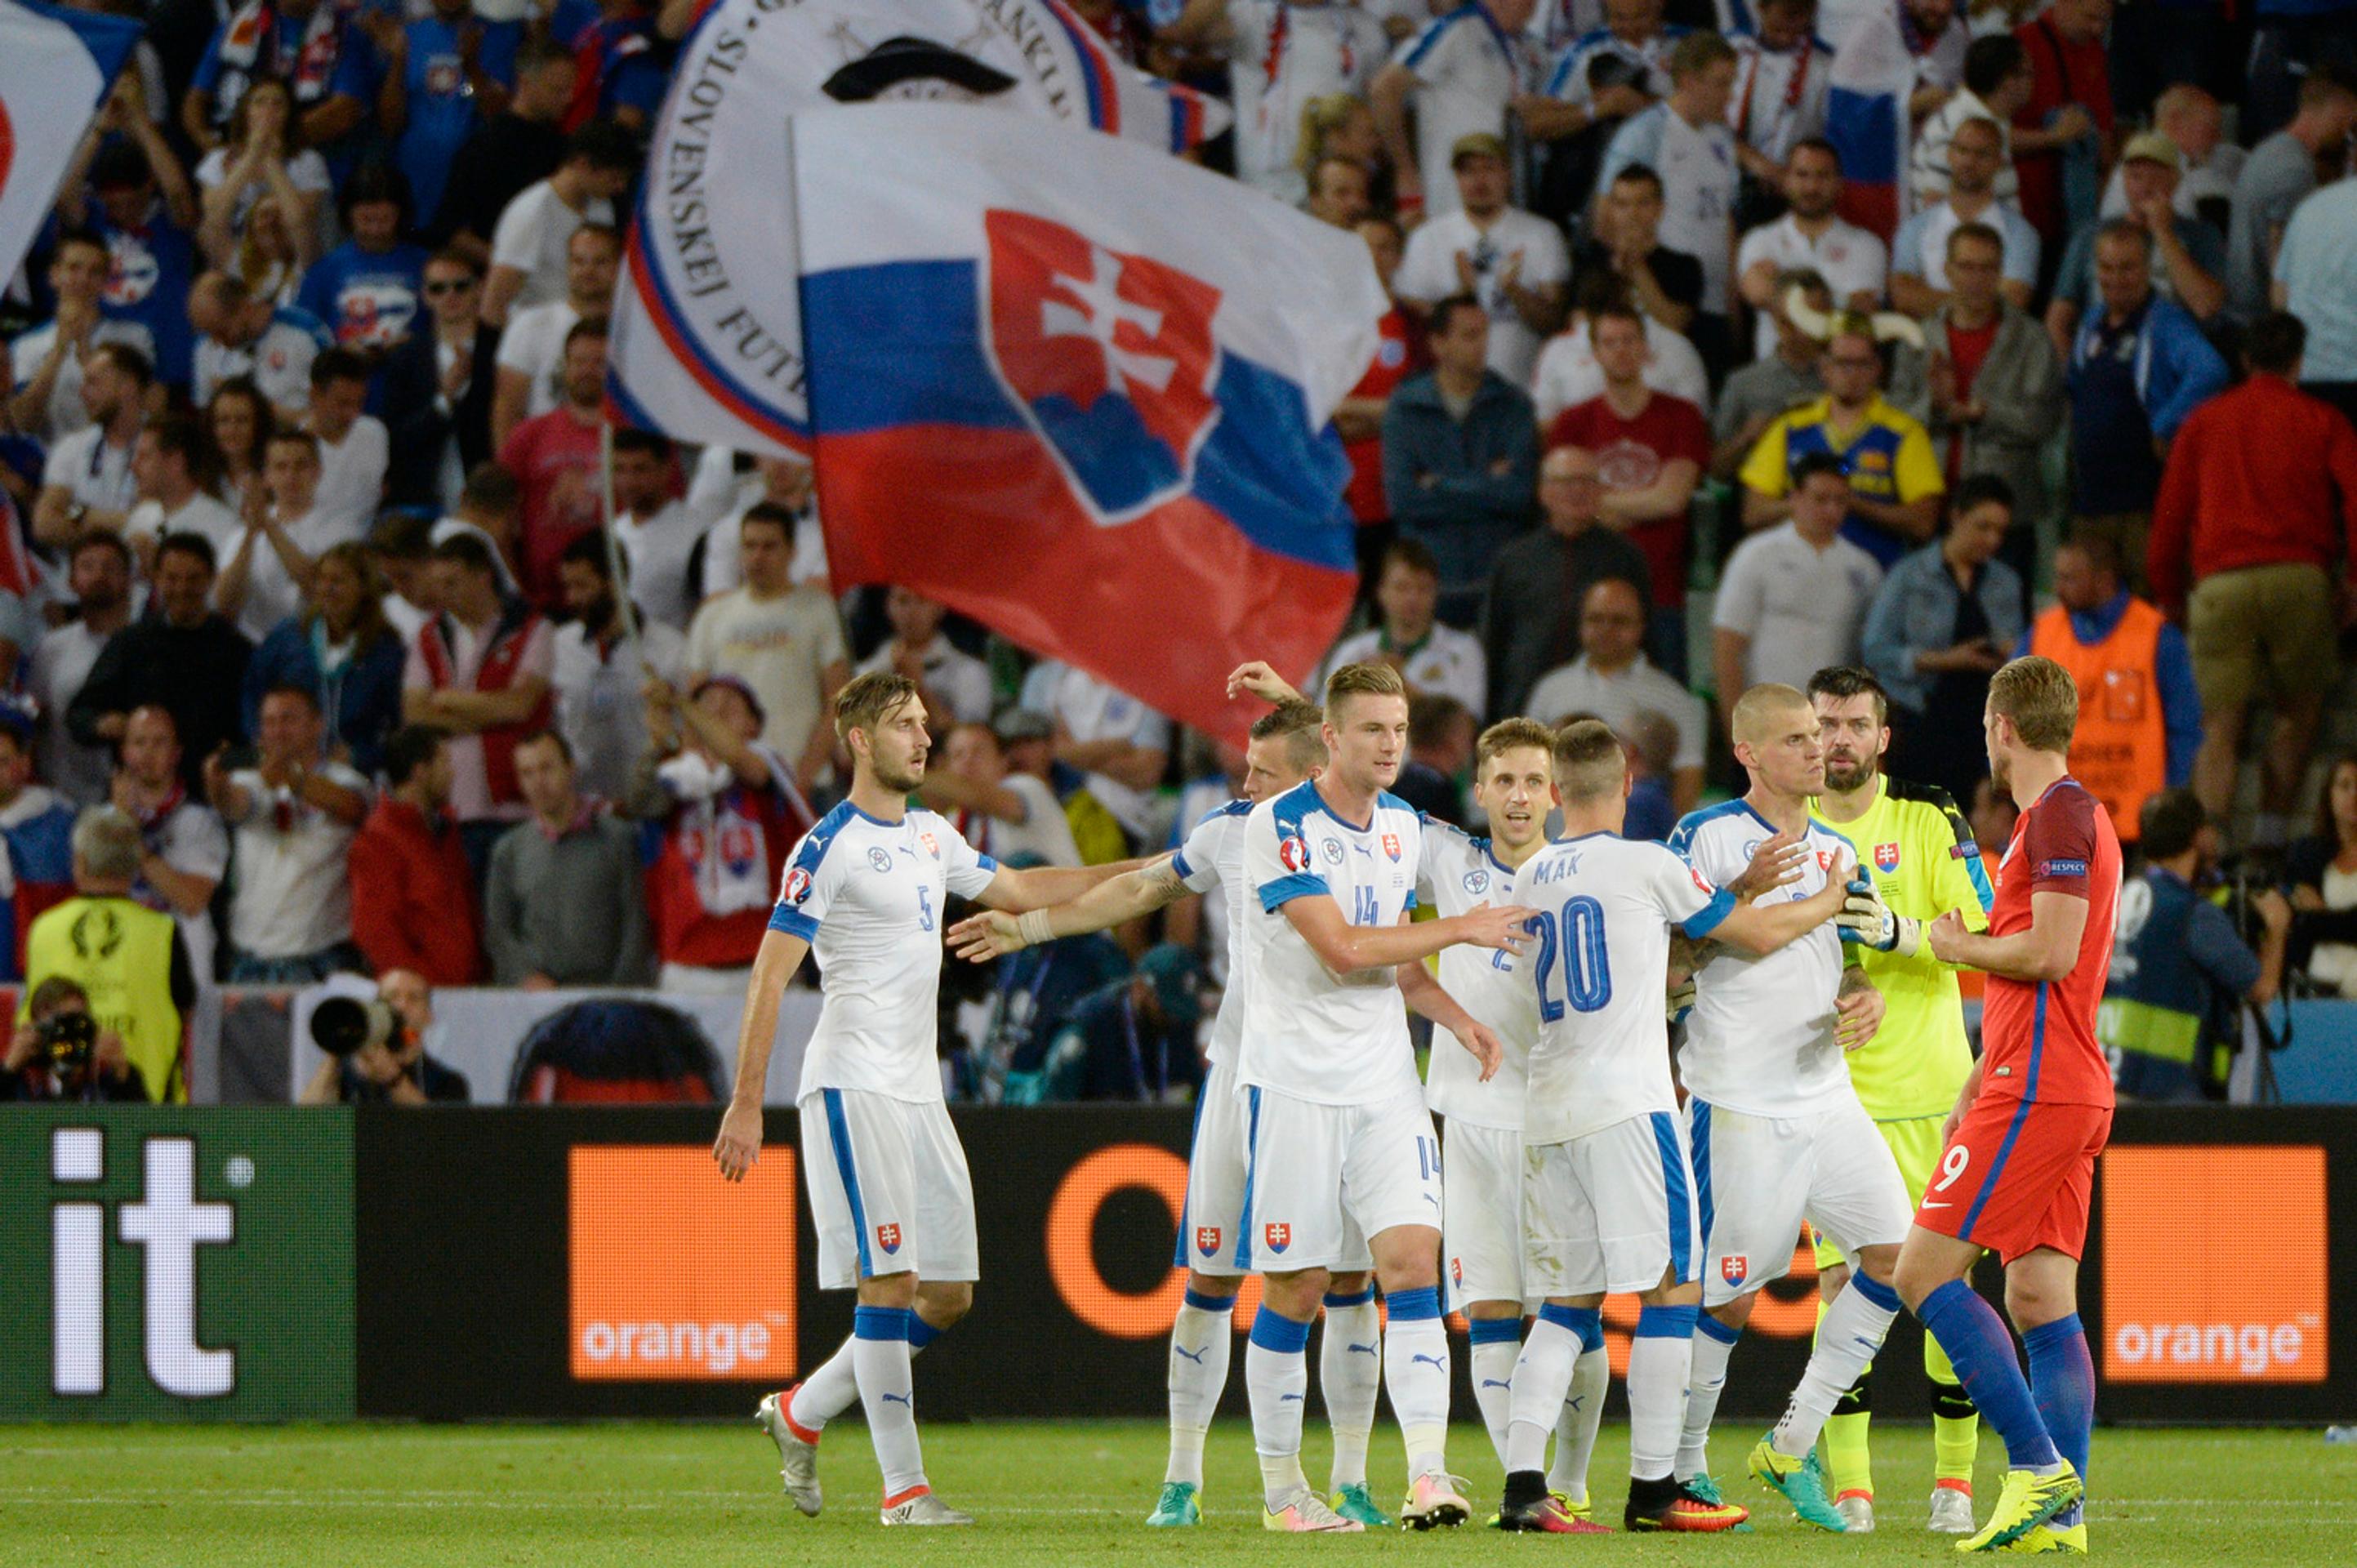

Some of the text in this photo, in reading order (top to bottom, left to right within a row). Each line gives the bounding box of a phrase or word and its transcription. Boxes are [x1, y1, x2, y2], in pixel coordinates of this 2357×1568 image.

[669, 28, 749, 298] SLOVENSKEJ
[1532, 852, 1584, 886] MAK
[916, 884, 934, 933] 5
[1354, 884, 1379, 926] 14
[1522, 894, 1613, 1024] 20
[1934, 1144, 1970, 1192] 9
[53, 1127, 235, 1396] it
[581, 1319, 771, 1375] orange
[2114, 1321, 2305, 1375] orange
